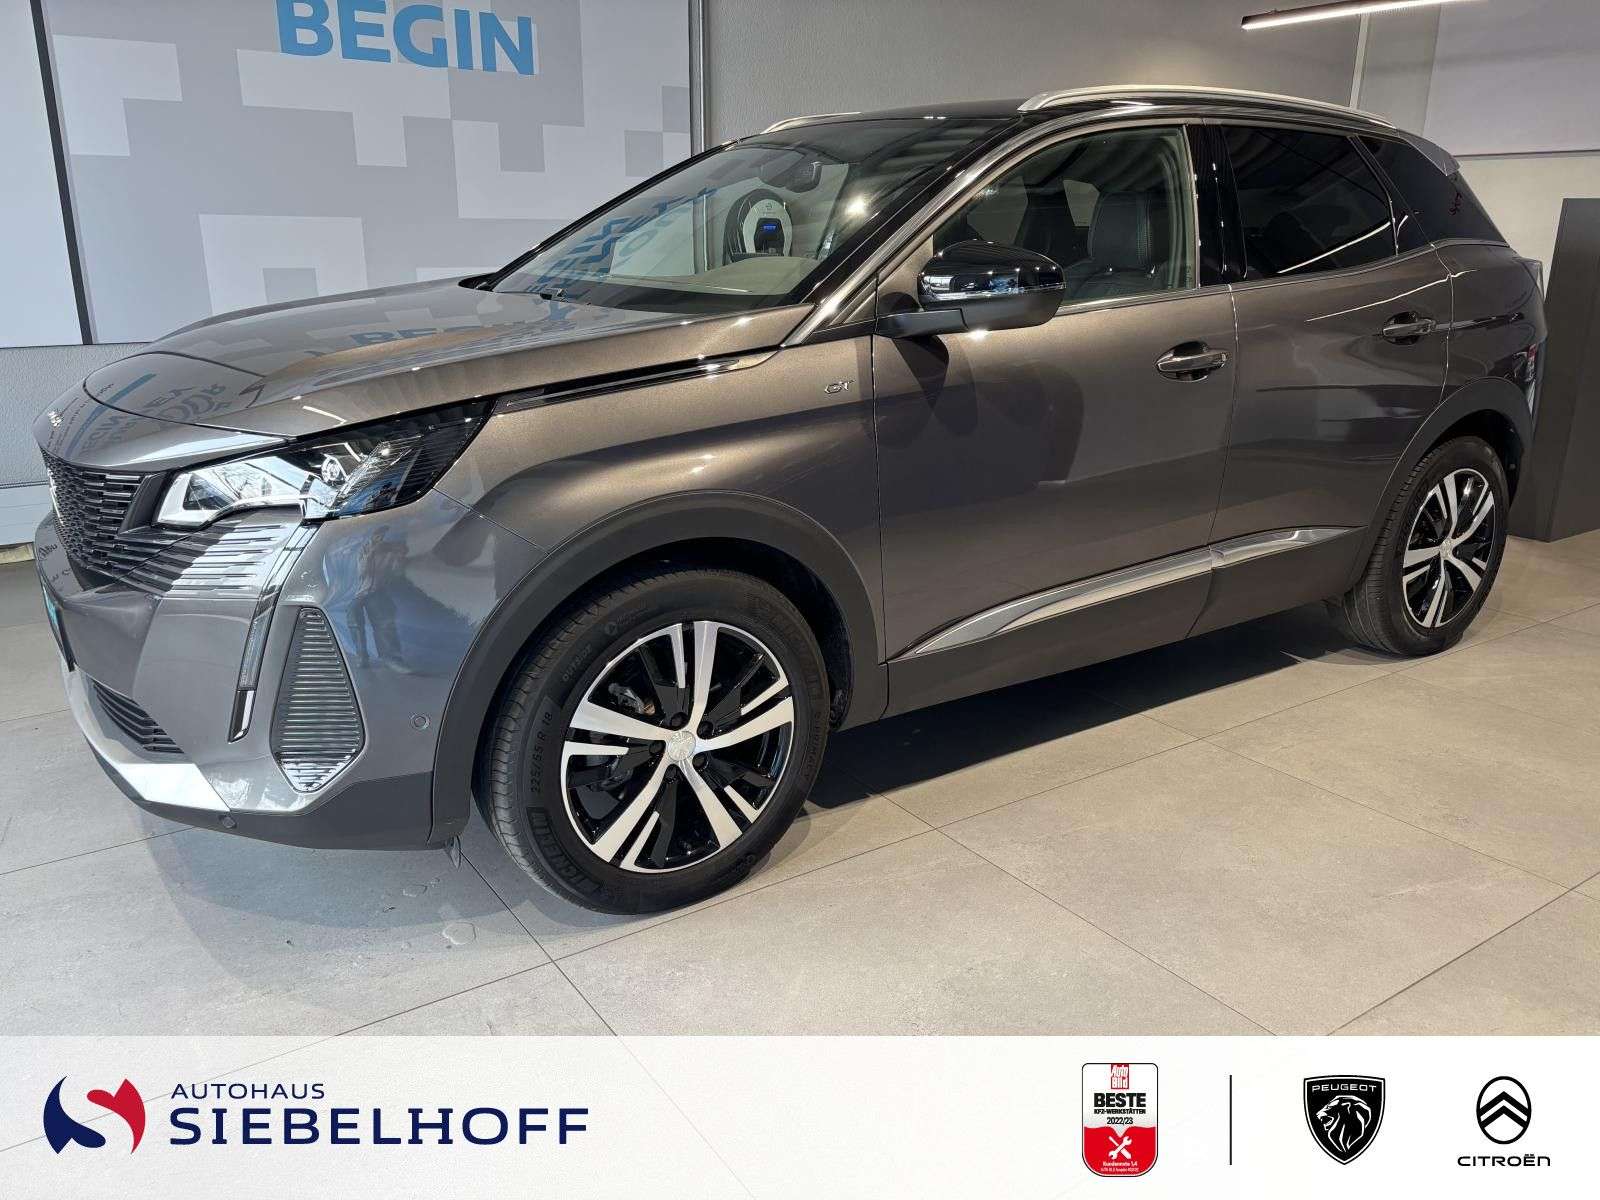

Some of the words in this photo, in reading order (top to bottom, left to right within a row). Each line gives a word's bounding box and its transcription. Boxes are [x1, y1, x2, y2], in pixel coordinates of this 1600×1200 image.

[275, 0, 536, 76] BEGIN
[824, 379, 857, 395] GT
[543, 711, 553, 727] 18
[536, 731, 546, 742] R
[531, 744, 544, 793] 225/55
